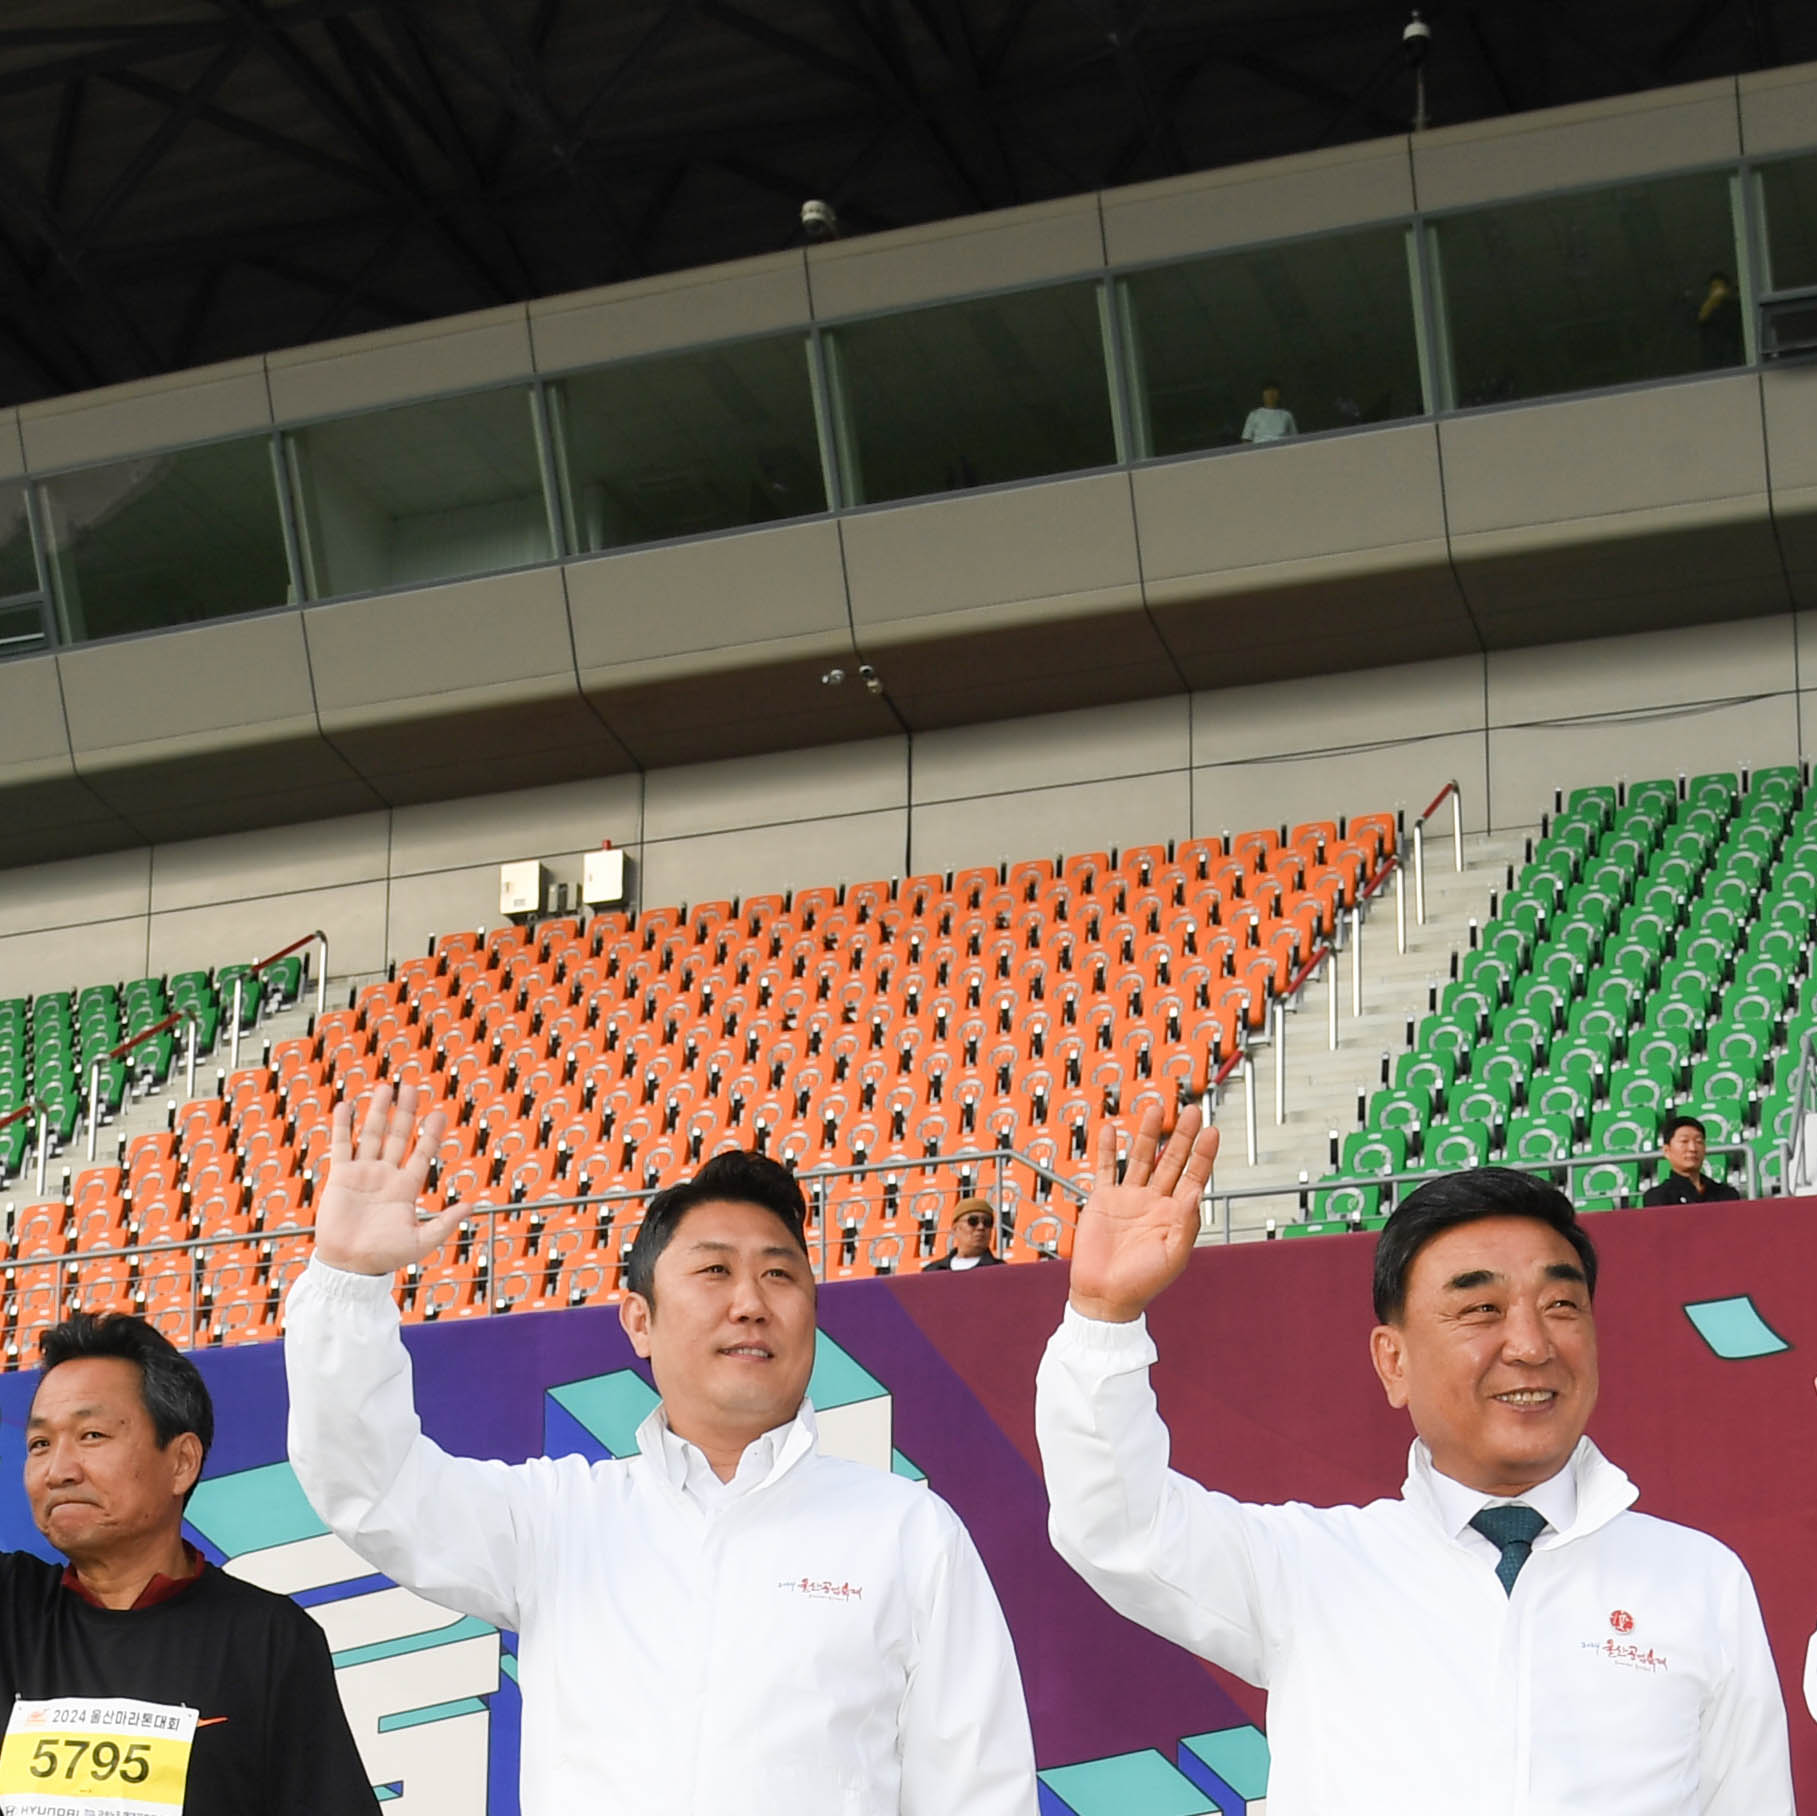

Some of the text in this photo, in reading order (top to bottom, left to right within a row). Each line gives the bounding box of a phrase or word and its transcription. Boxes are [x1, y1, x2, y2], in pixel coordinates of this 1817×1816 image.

[52, 1709, 180, 1731] 2024 울산마라톤대회
[30, 1739, 151, 1784] 5795
